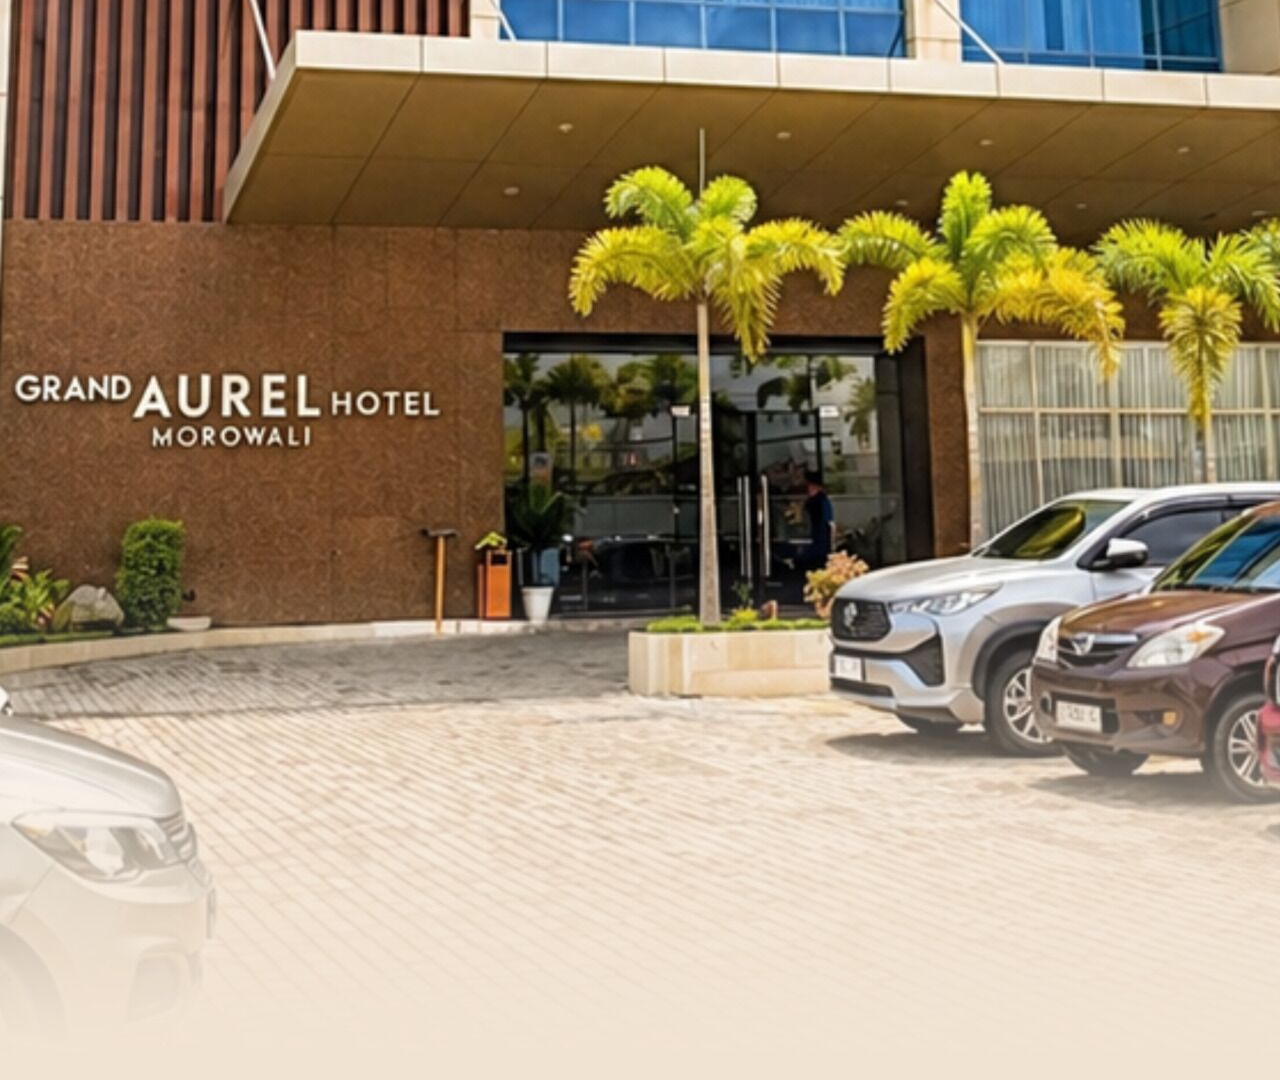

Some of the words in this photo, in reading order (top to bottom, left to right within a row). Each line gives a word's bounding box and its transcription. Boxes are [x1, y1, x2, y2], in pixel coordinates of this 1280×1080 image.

[14, 374, 132, 402] GRAND
[132, 373, 321, 419] AUREL
[331, 391, 441, 417] HOTEL
[152, 426, 312, 448] MOROWALI
